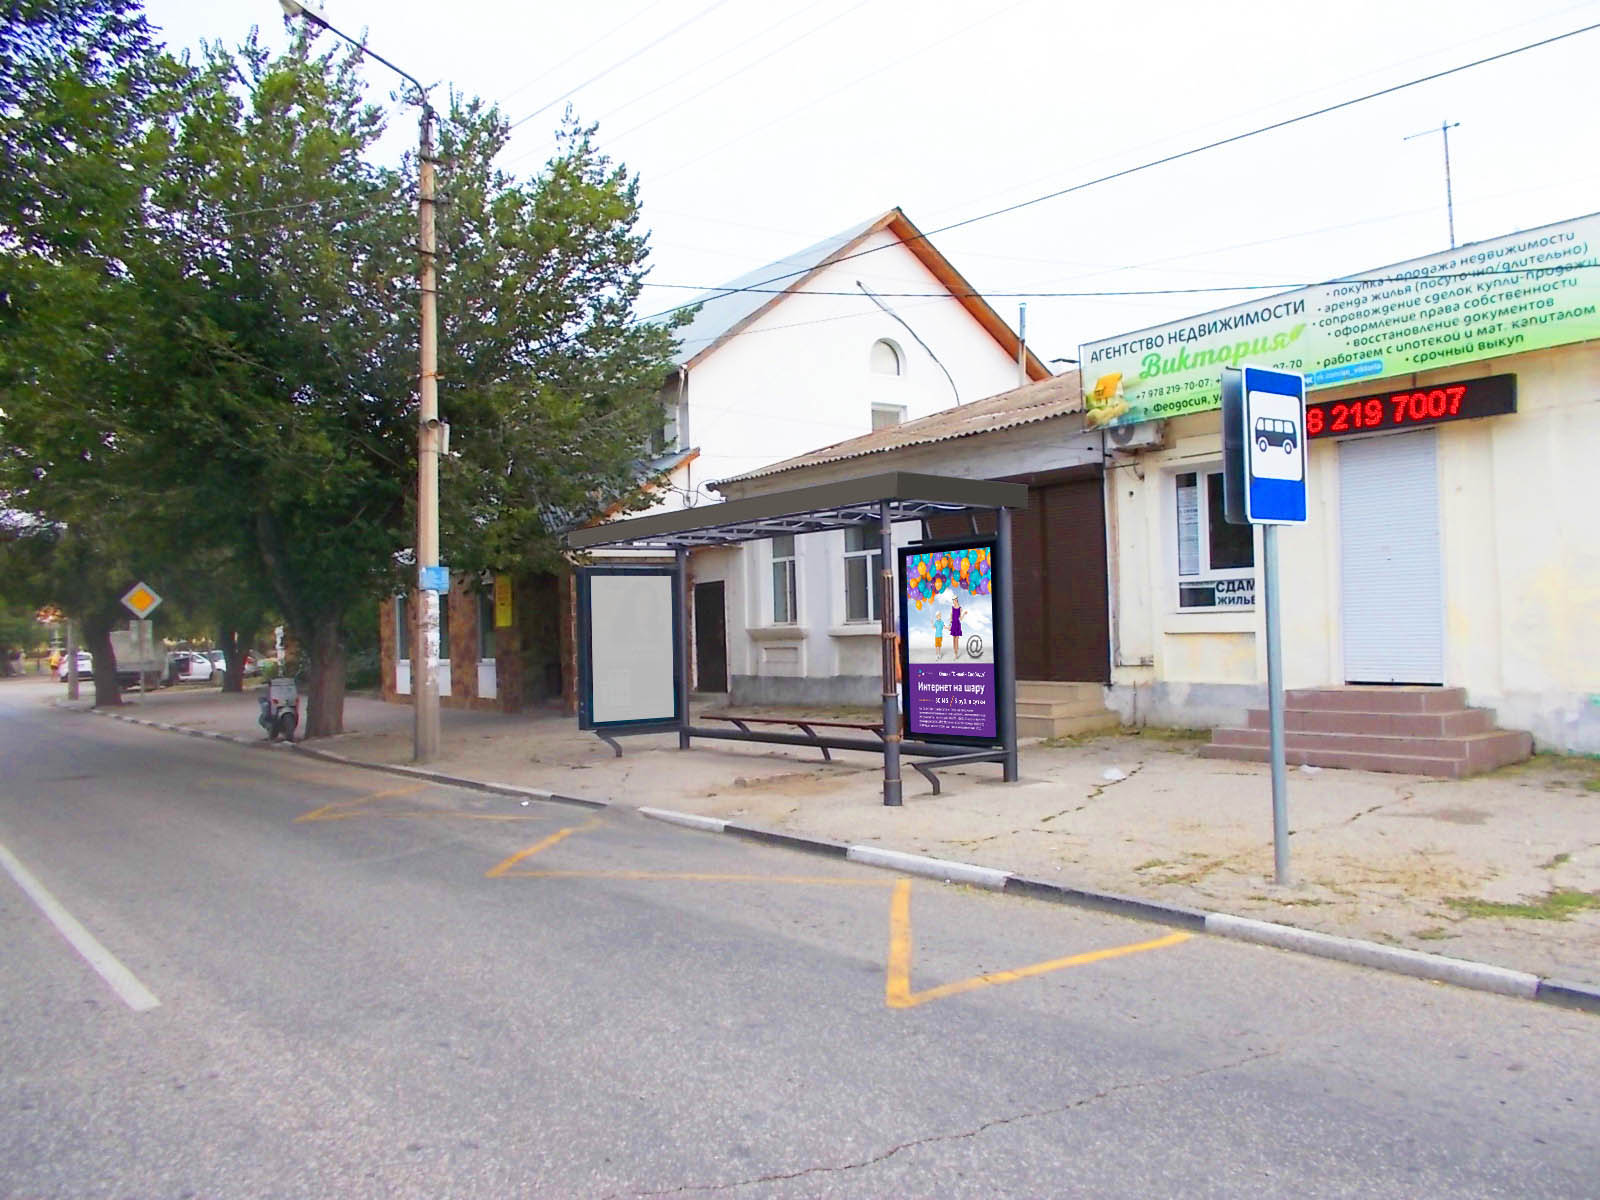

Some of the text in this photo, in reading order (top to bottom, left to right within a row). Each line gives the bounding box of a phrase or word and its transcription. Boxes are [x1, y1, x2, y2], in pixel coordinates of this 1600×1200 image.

[1333, 278, 1384, 297] покупка
[1396, 260, 1456, 283] продажа
[1460, 232, 1575, 266] недвижимости
[1319, 257, 1597, 328] сопровождение сделок купли-продажи
[1324, 296, 1368, 313] аренда
[1371, 285, 1411, 302] жилья
[1334, 278, 1577, 338] оформление права собственности
[1090, 299, 1305, 363] АГЕНТСТВО НЕДВИЖИМОСТИ
[1323, 347, 1383, 368] работаем
[1386, 345, 1392, 354] с
[1396, 330, 1460, 352] ипотекой
[1464, 329, 1472, 338] и
[1511, 305, 1596, 329] капиталом
[1353, 298, 1554, 347] восстановление документов
[1138, 332, 1289, 379] Виктория
[1413, 334, 1524, 364] срочный выкуп
[1148, 387, 1164, 397] 978
[1331, 399, 1383, 431] 219
[1391, 386, 1467, 423] 7007
[918, 681, 985, 694] Интернет на шару
